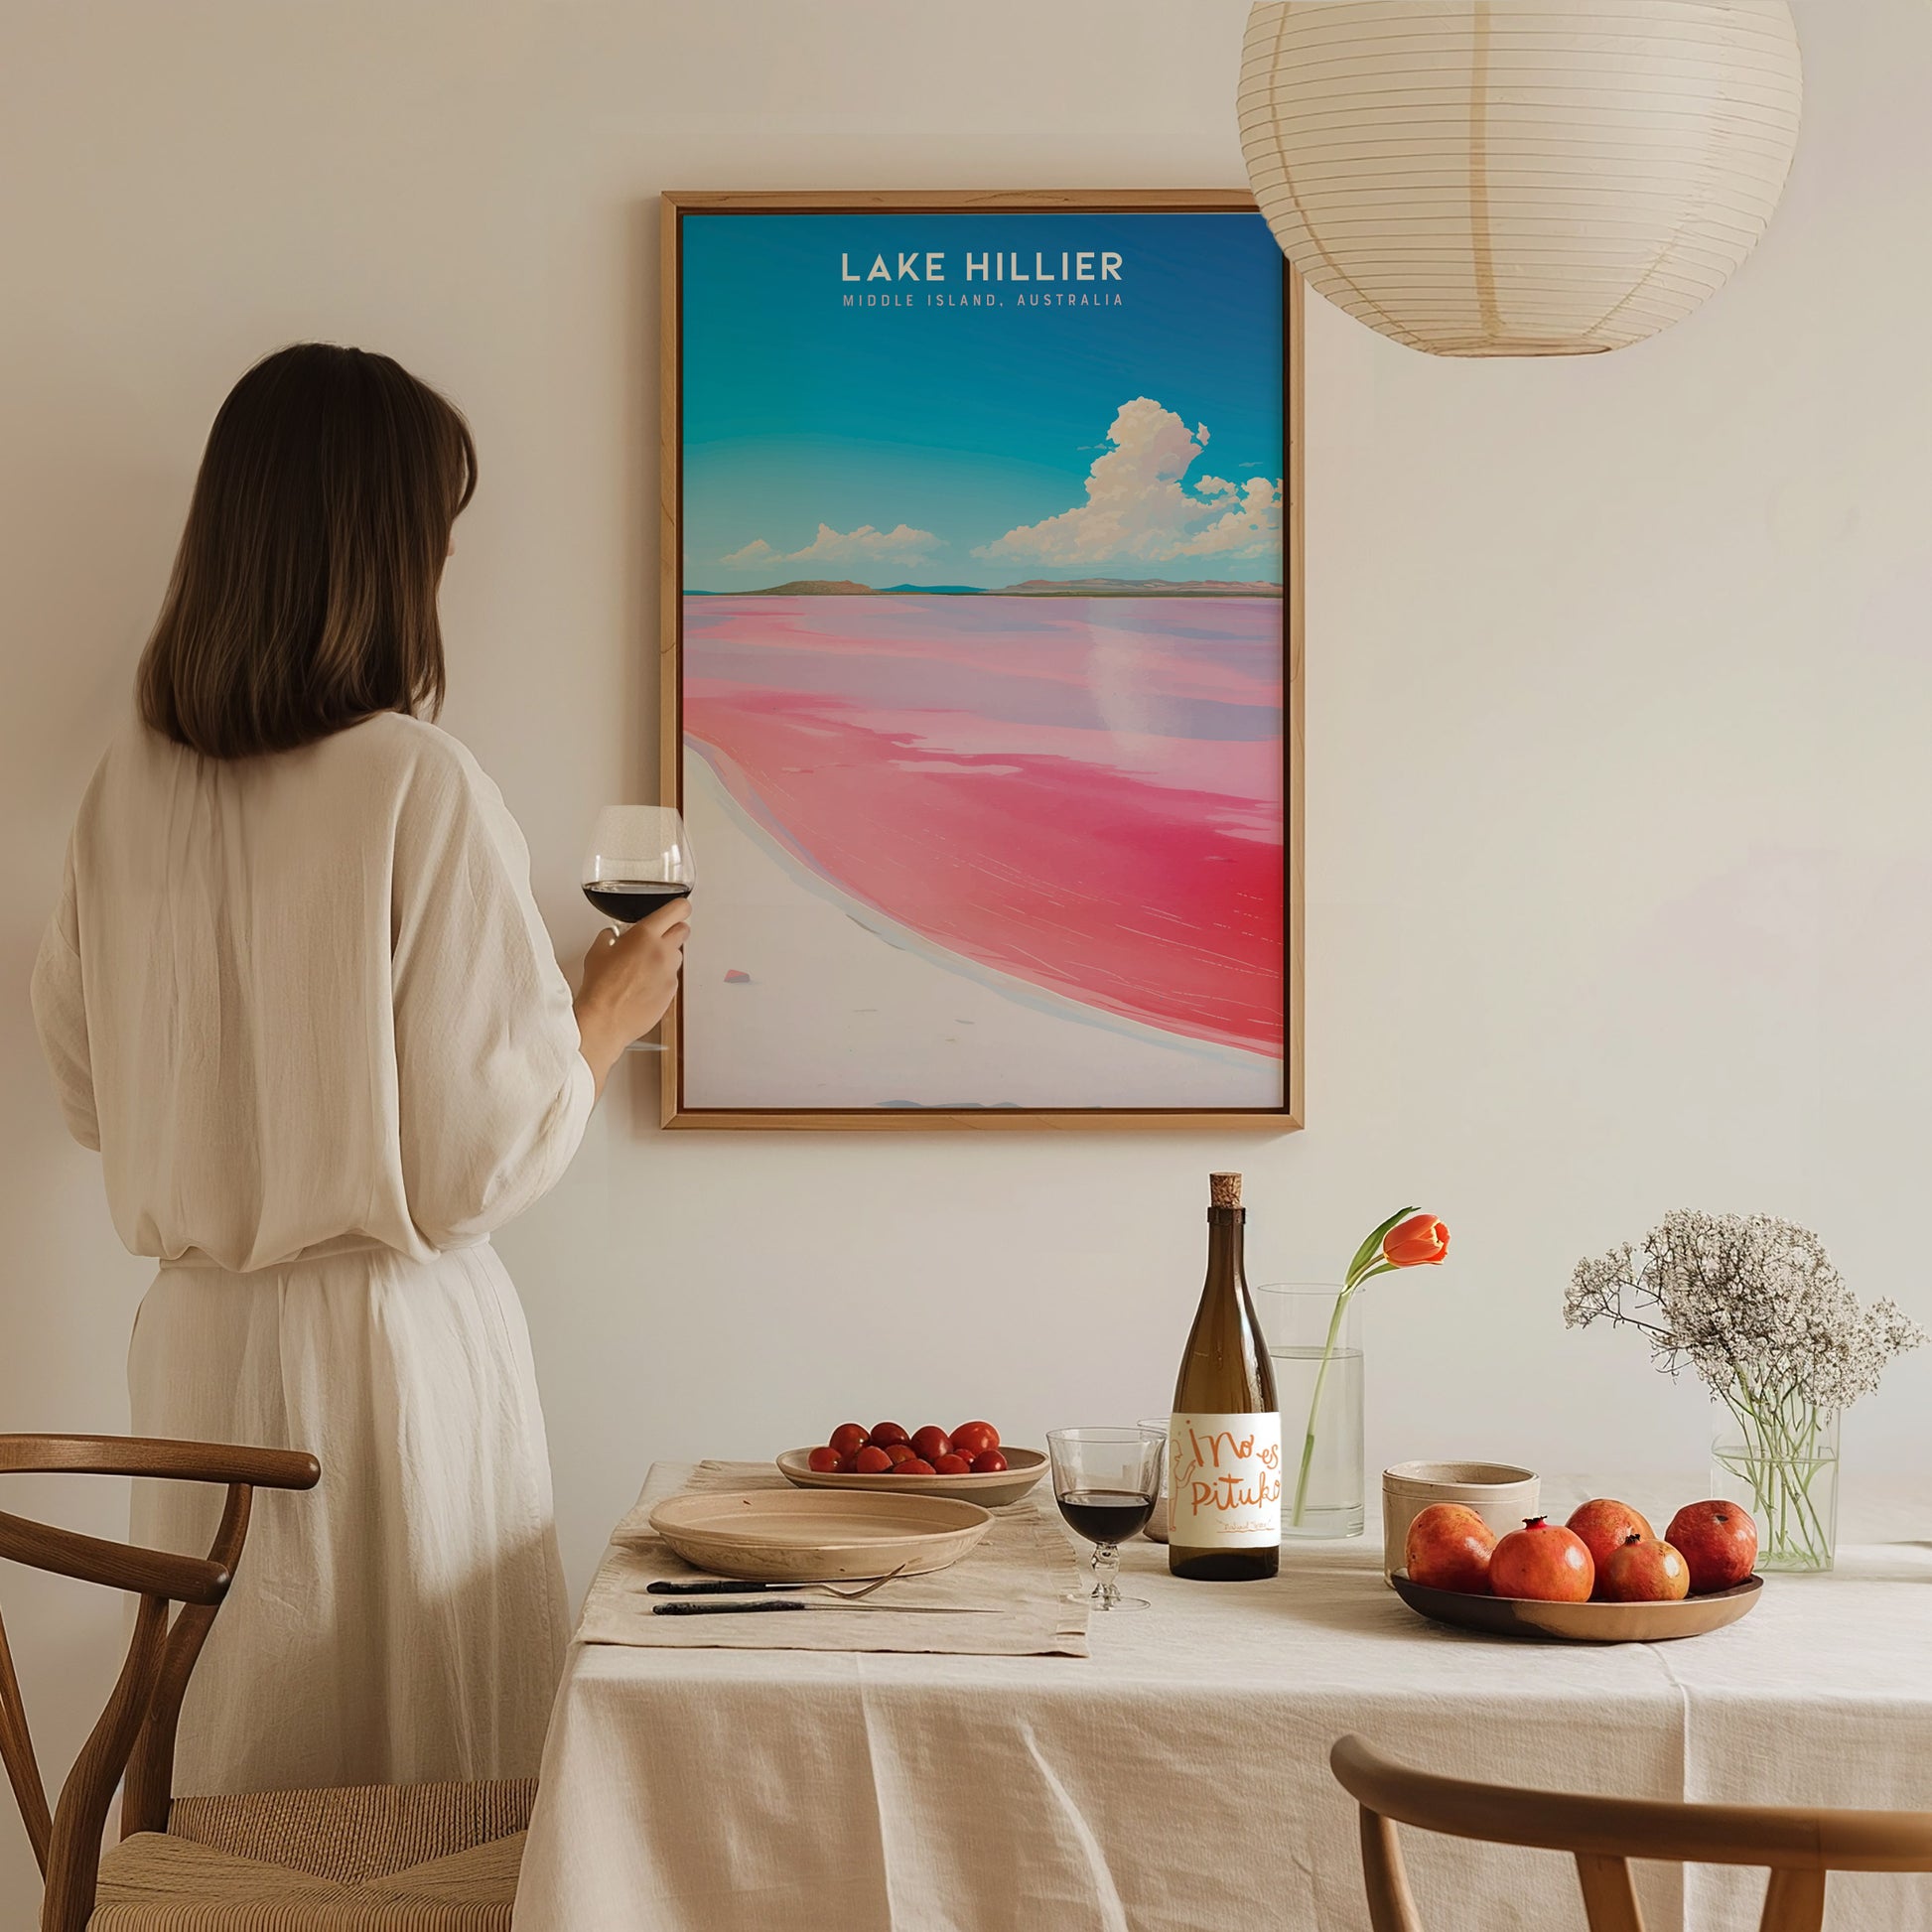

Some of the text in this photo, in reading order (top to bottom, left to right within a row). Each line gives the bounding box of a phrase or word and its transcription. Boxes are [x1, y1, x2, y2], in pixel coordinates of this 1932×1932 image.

[842, 251, 1124, 282] LAKE HILLIER
[842, 293, 1123, 308] MIDDLE ISLAND, AUSTRALIA
[1257, 1444, 1279, 1469] es
